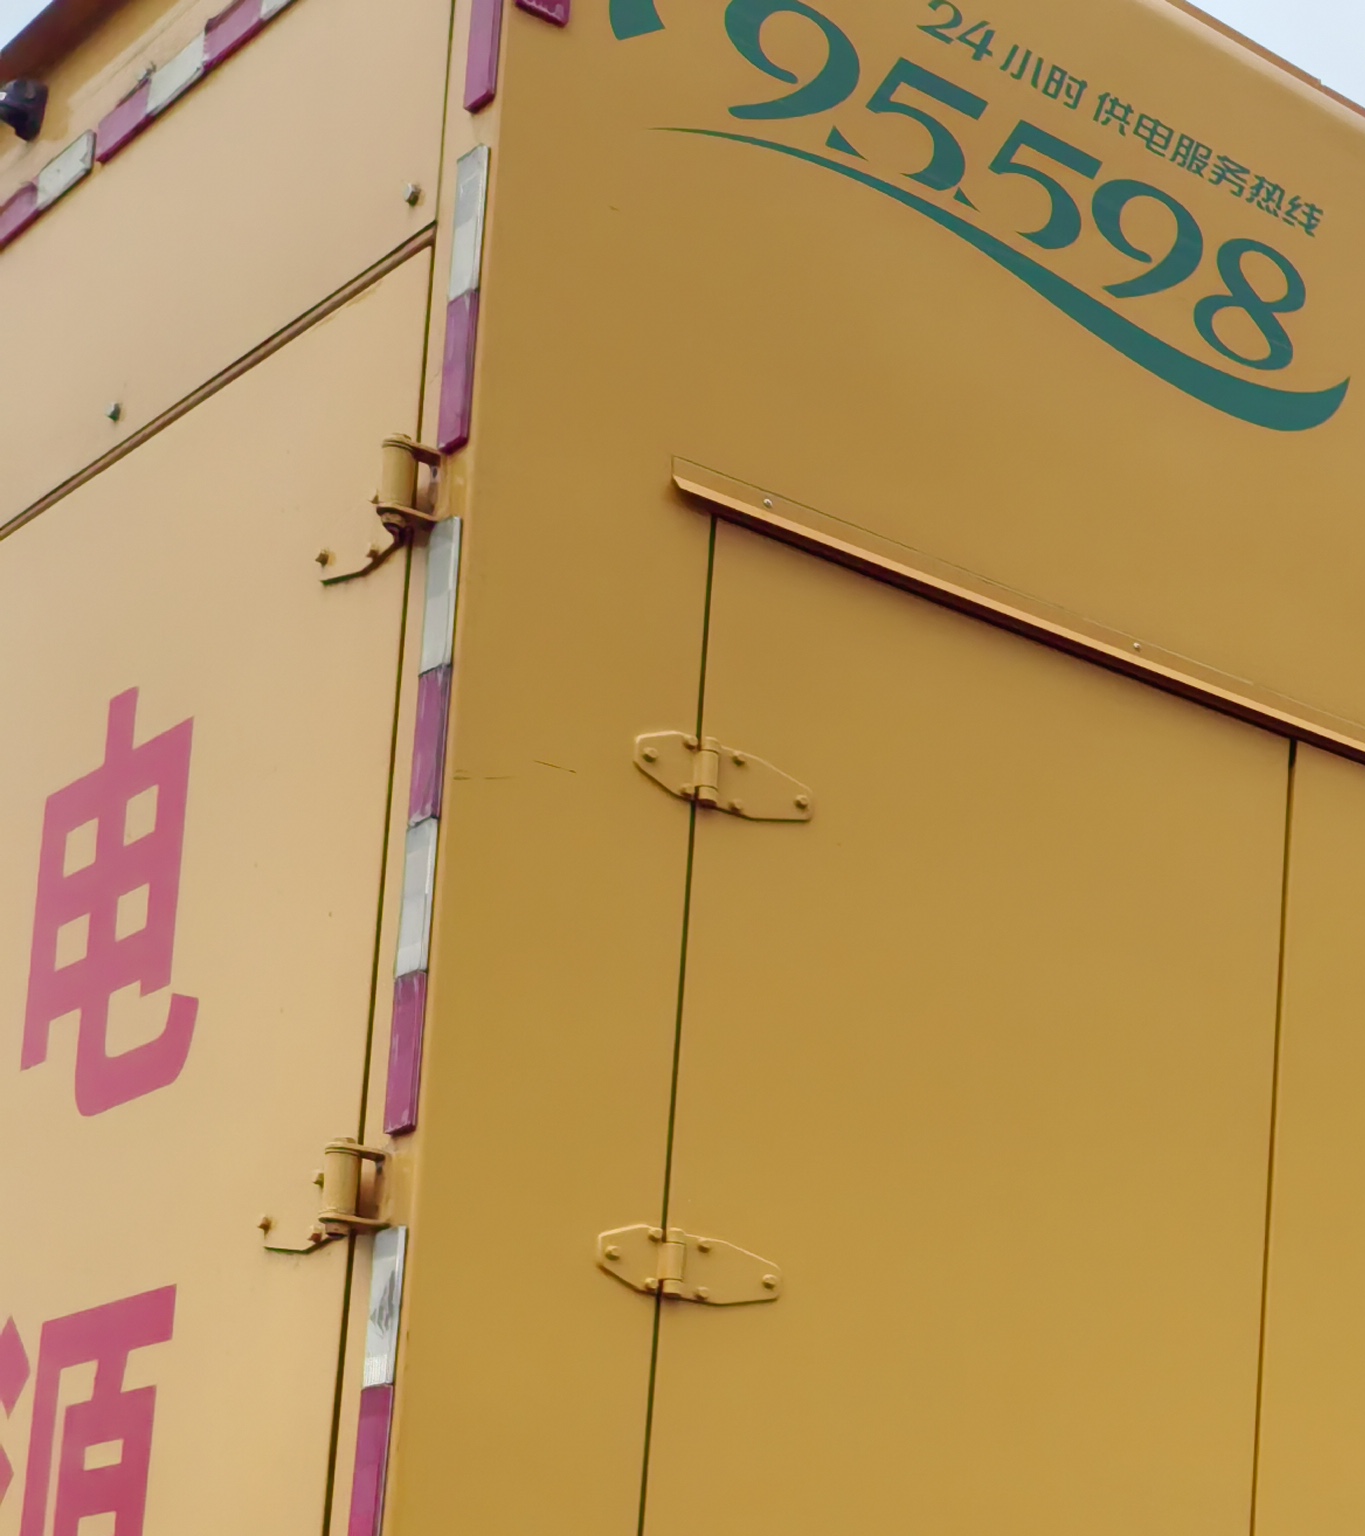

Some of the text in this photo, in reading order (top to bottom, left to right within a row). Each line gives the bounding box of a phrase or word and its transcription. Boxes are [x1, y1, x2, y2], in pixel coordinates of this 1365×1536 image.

[724, 0, 1307, 371] 95598
[916, 0, 1325, 238] 24 小时 供电服务热线
